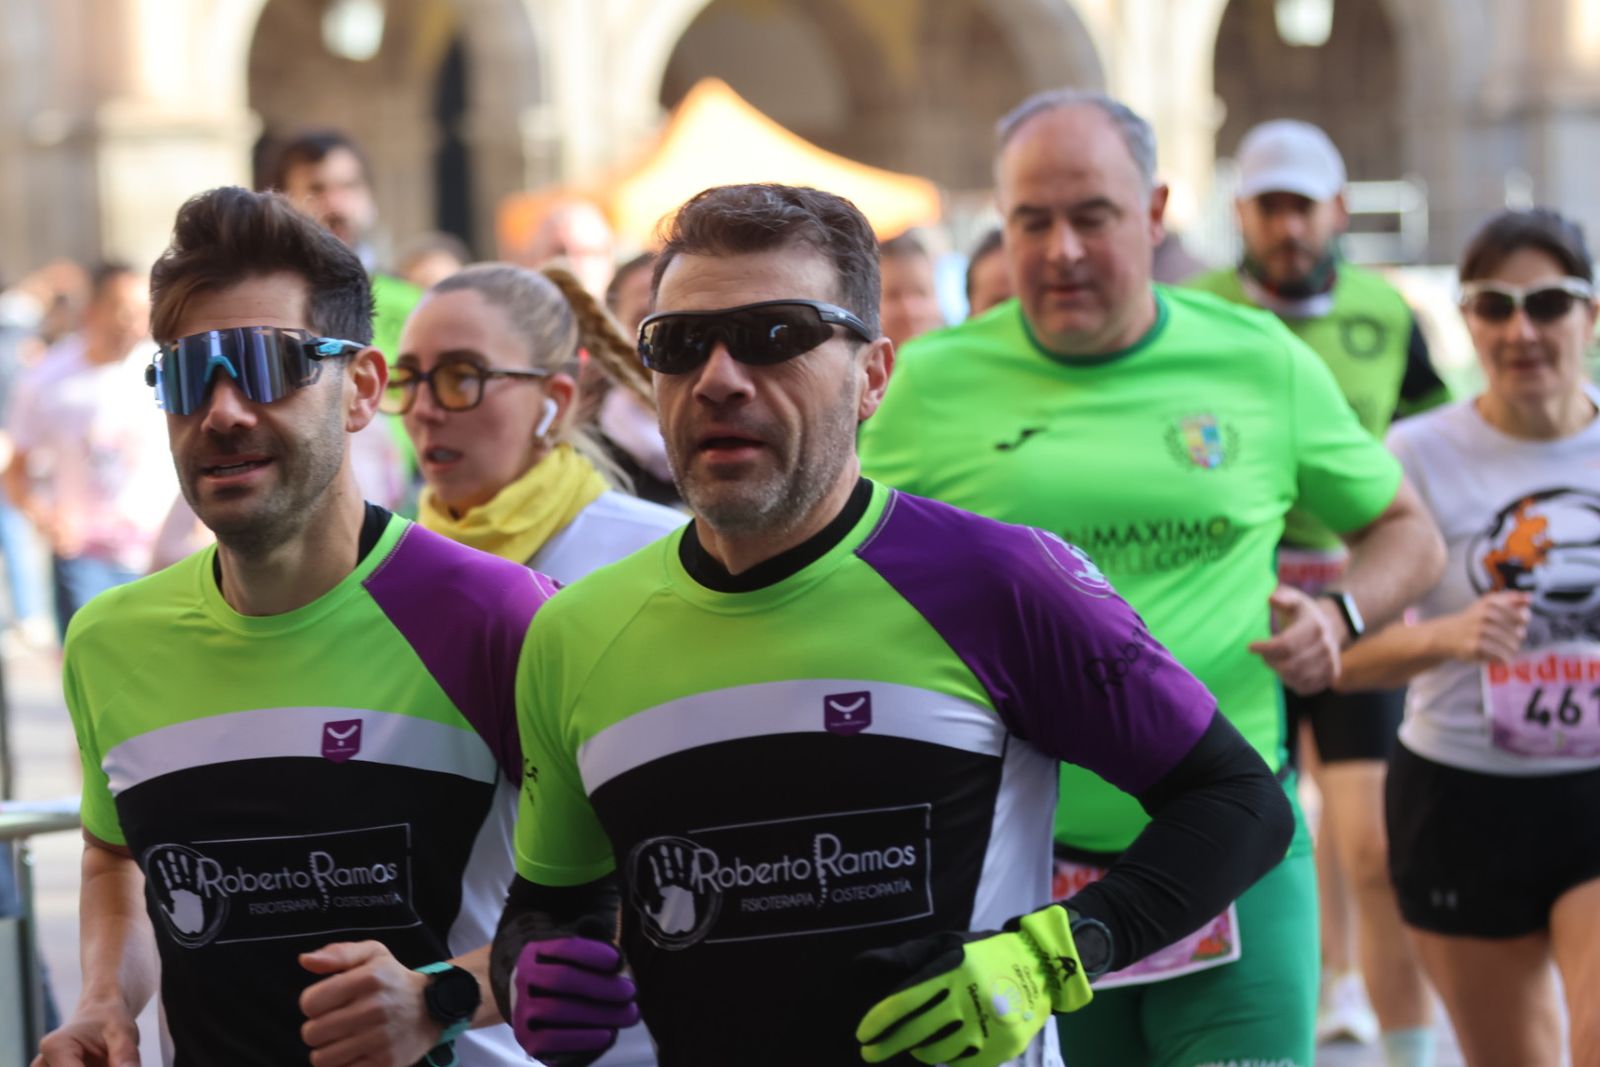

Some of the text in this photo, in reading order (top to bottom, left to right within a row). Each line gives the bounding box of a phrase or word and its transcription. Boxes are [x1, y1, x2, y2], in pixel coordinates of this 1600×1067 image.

[197, 850, 398, 899] Roberto Ramos
[696, 833, 916, 895] Roberto Ramos
[741, 893, 815, 913] FISIOTERAPIA
